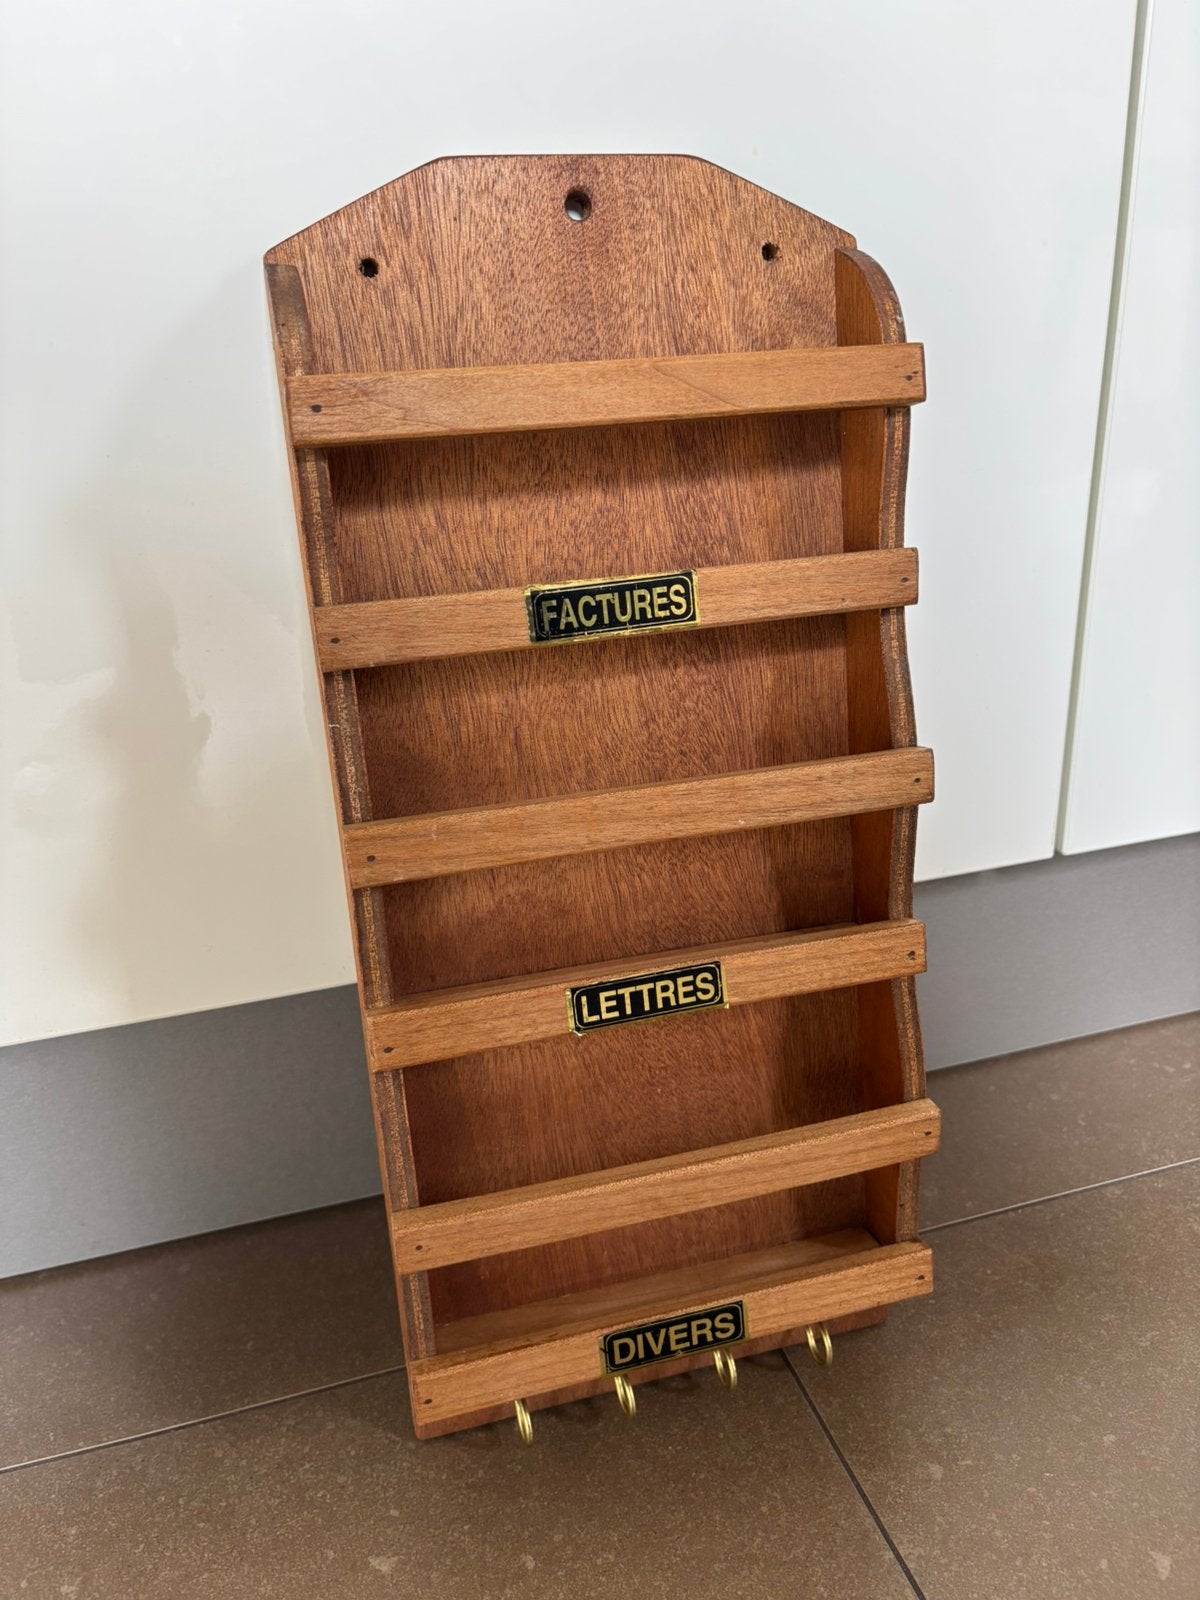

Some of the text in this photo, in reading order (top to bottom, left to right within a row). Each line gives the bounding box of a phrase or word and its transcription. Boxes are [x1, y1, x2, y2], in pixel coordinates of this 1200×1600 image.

[541, 583, 688, 634] FACTURES
[581, 972, 716, 1023] LETTRES
[612, 1312, 736, 1367] DIVERS
